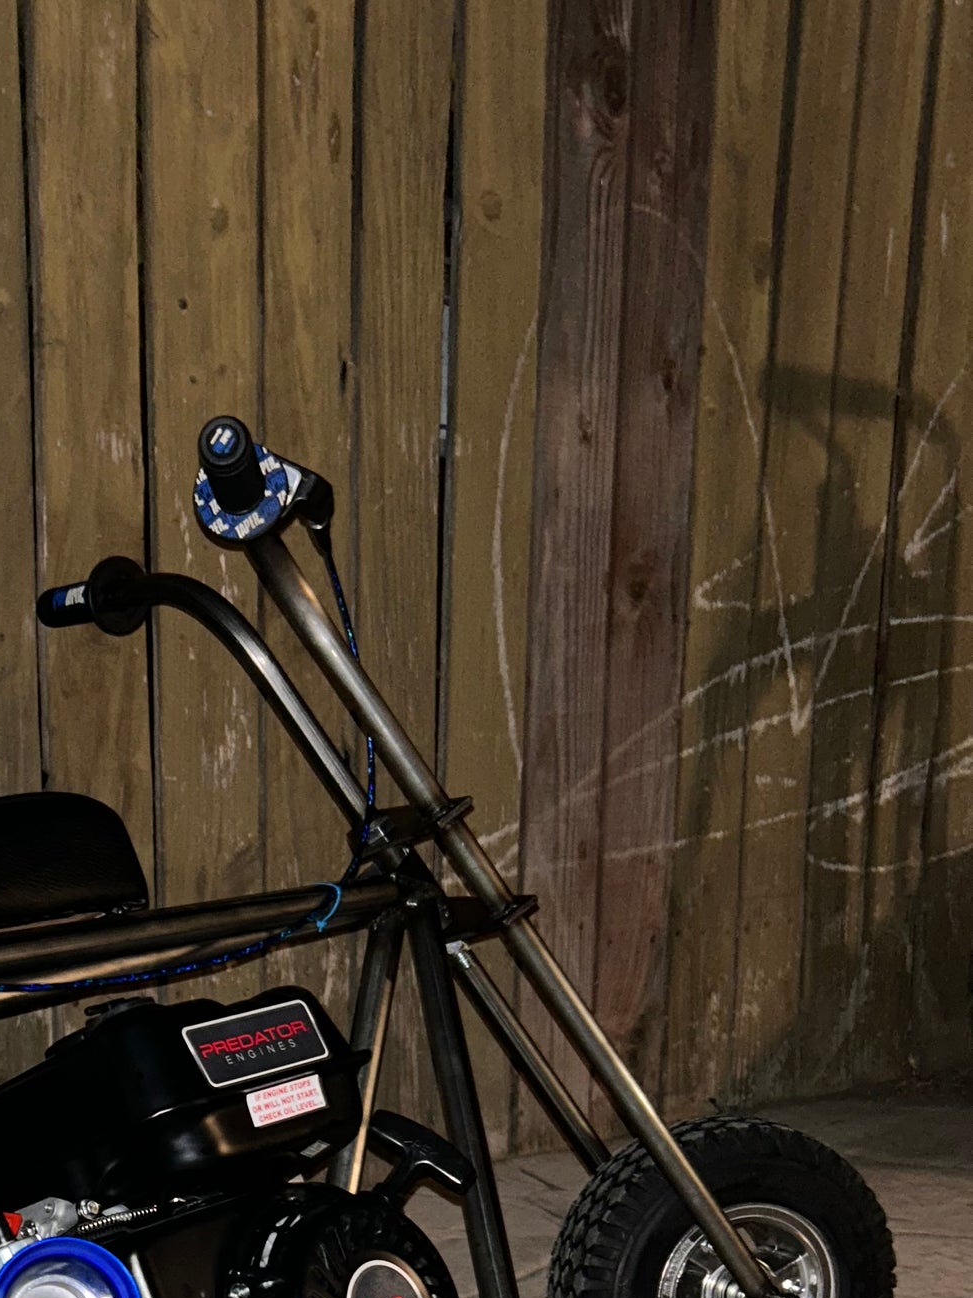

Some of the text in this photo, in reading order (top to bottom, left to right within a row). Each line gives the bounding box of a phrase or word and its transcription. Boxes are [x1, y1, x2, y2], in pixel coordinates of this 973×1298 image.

[199, 1020, 307, 1058] PREDATOR
[225, 1038, 297, 1065] ENGINES
[254, 1079, 311, 1102] IF ENGINE STOPS
[252, 1104, 263, 1114] OR
[263, 1100, 281, 1111] WILL
[280, 1095, 295, 1105] NOT
[258, 1110, 283, 1123] CHECK
[283, 1106, 296, 1116] OIL
